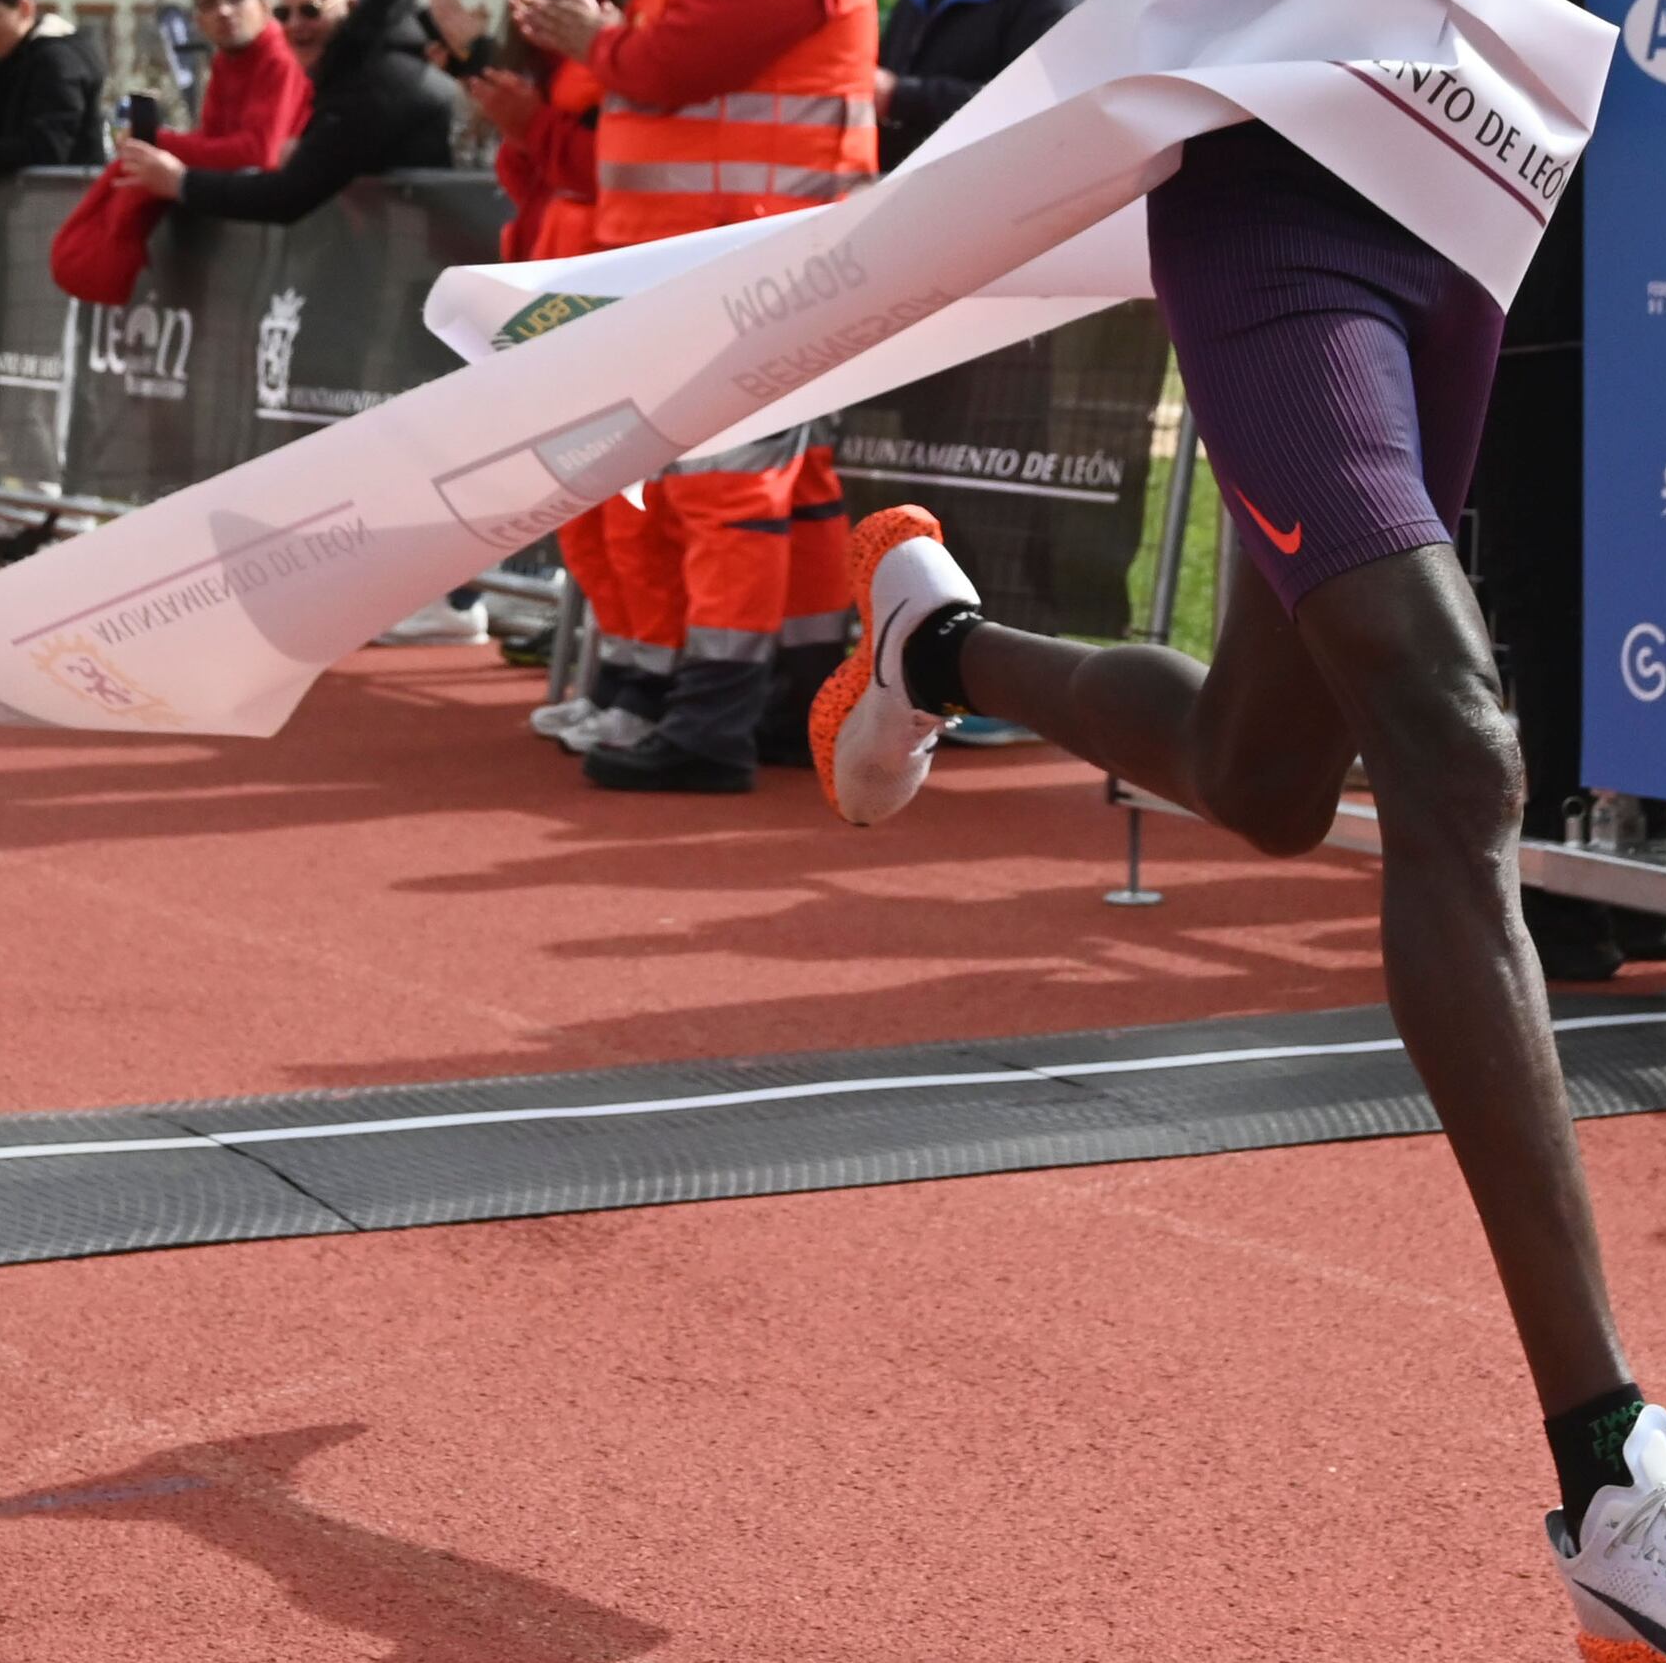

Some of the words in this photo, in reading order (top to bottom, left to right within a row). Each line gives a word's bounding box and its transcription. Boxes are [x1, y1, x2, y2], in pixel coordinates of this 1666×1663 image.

[1475, 109, 1521, 163] DE
[838, 435, 1021, 478] AYUNTAMIENTO
[1021, 450, 1058, 483] DE
